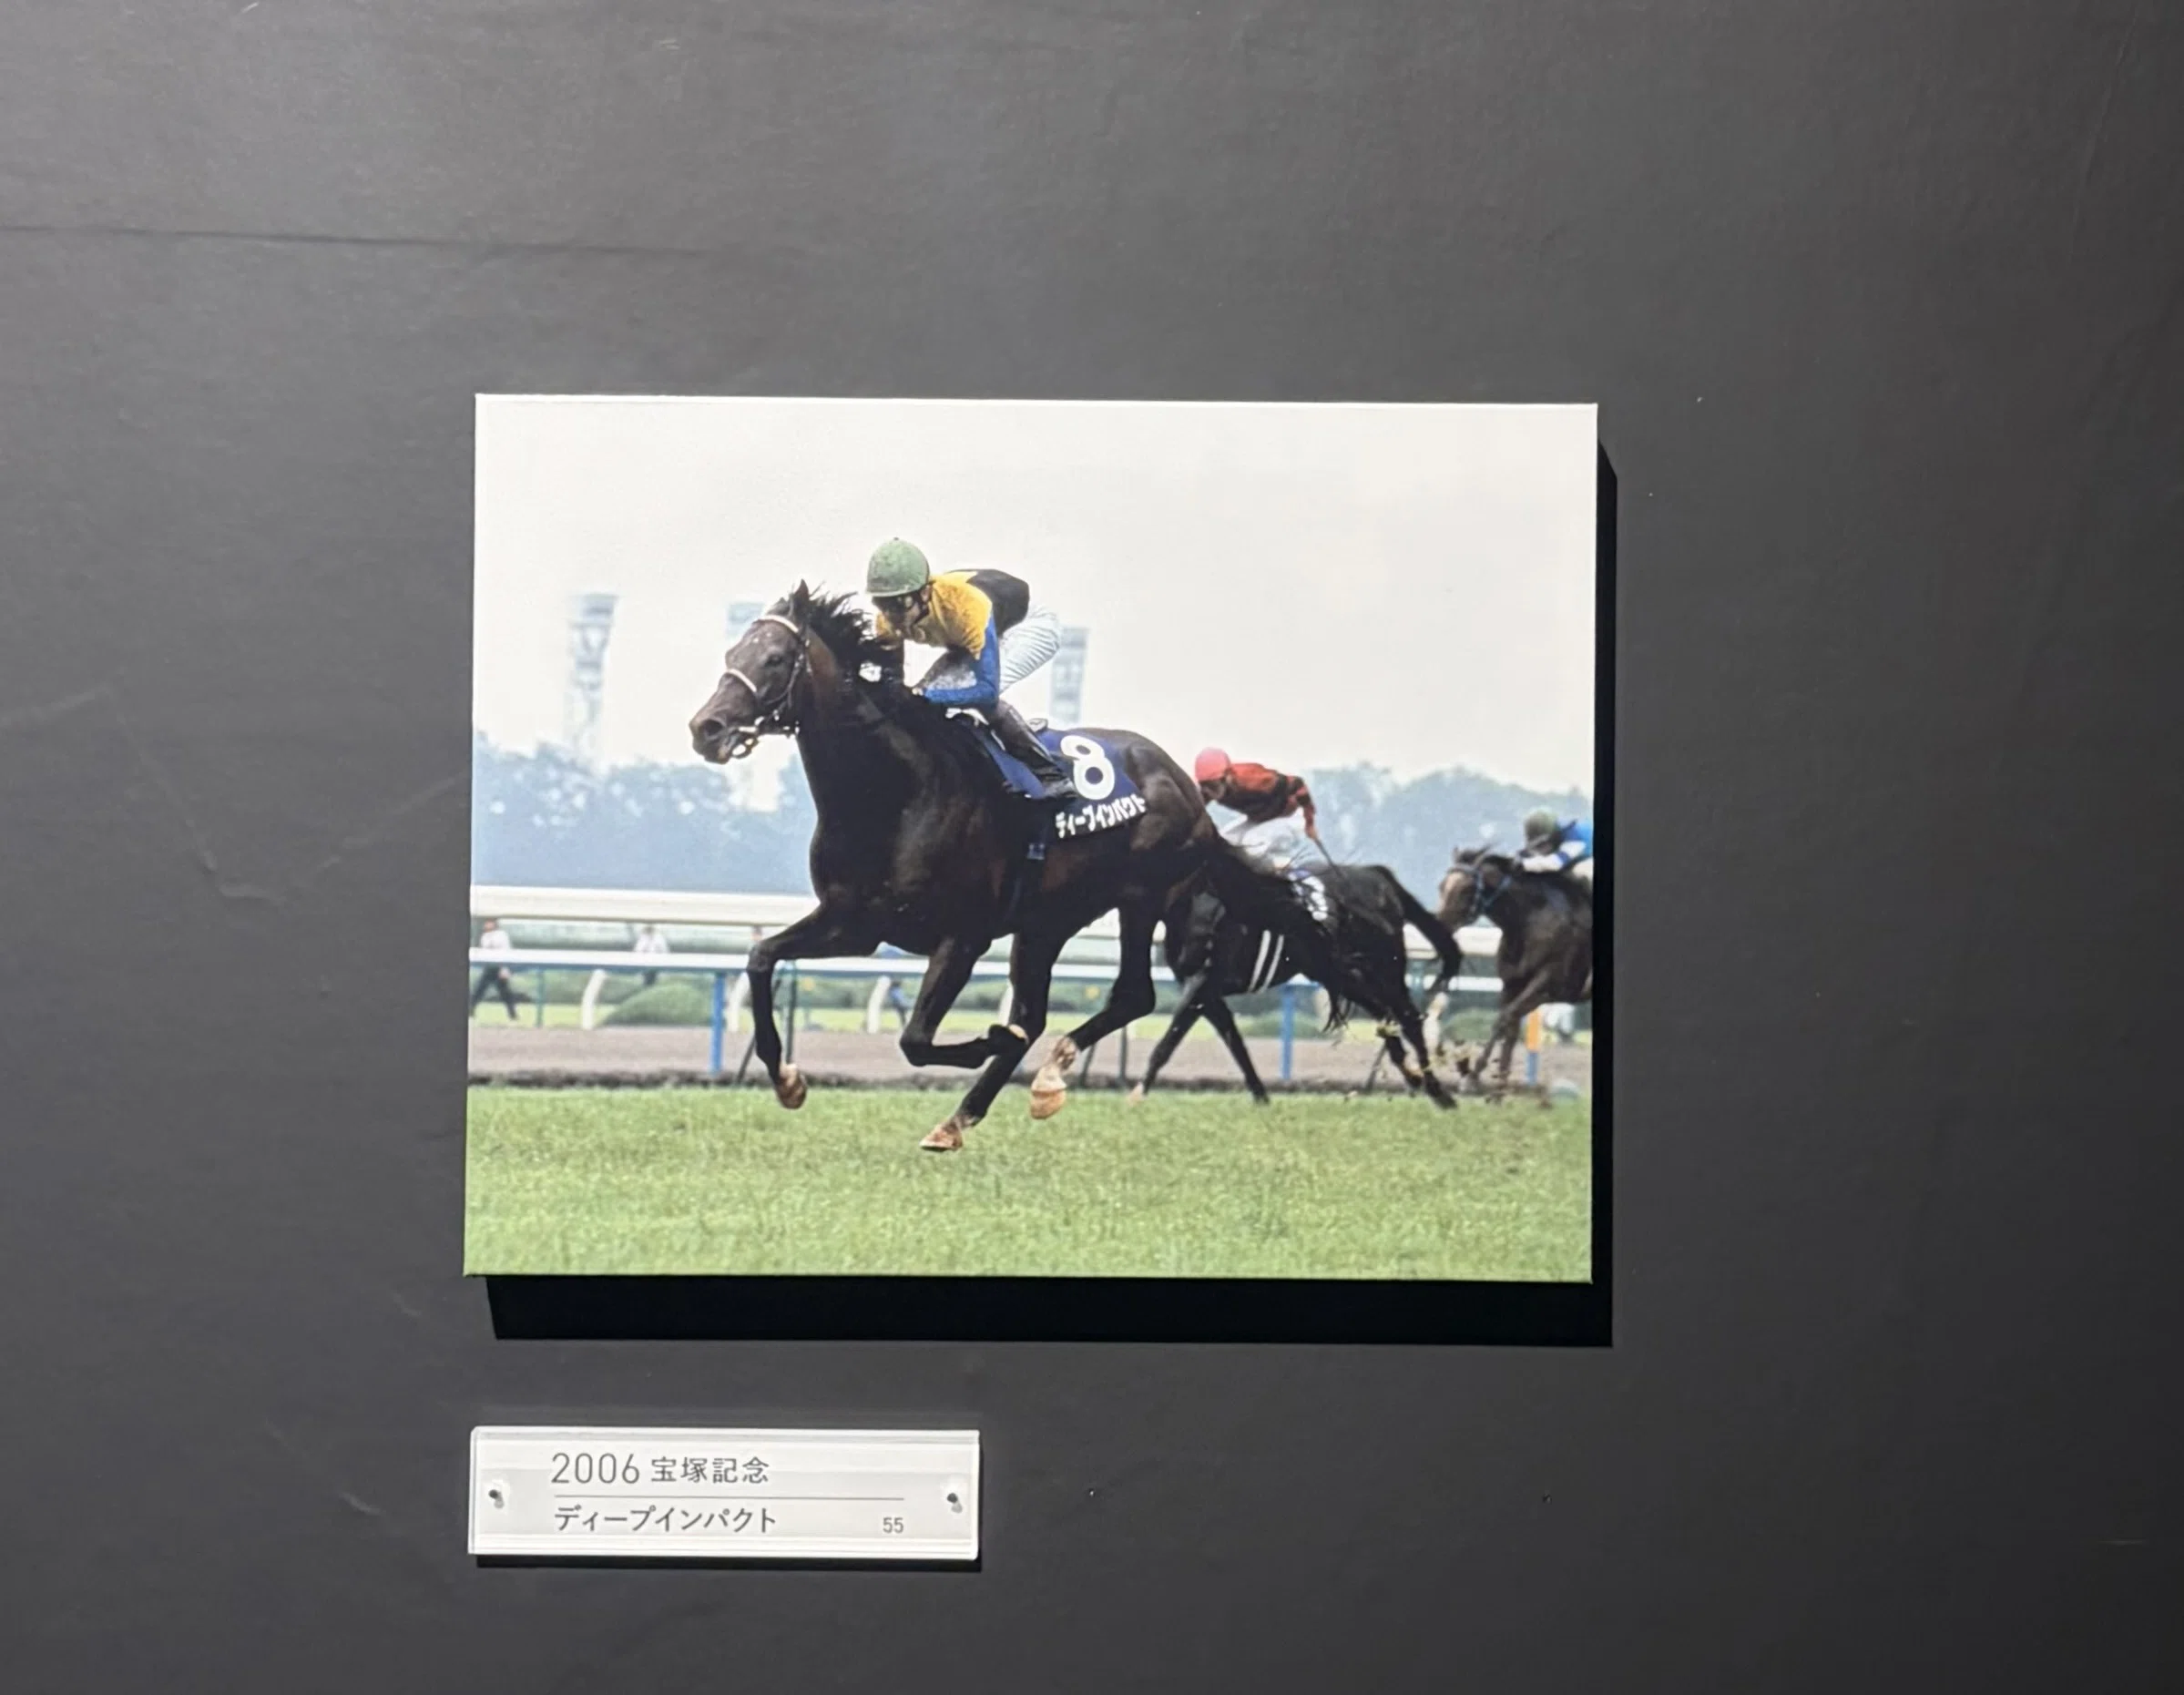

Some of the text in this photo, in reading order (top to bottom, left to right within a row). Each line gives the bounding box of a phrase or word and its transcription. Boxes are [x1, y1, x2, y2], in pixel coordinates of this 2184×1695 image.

[1060, 735, 1116, 800] 8
[551, 1453, 770, 1484] 2006 宝塚記念
[555, 1505, 776, 1533] ディープインパクト
[883, 1516, 904, 1534] 55
